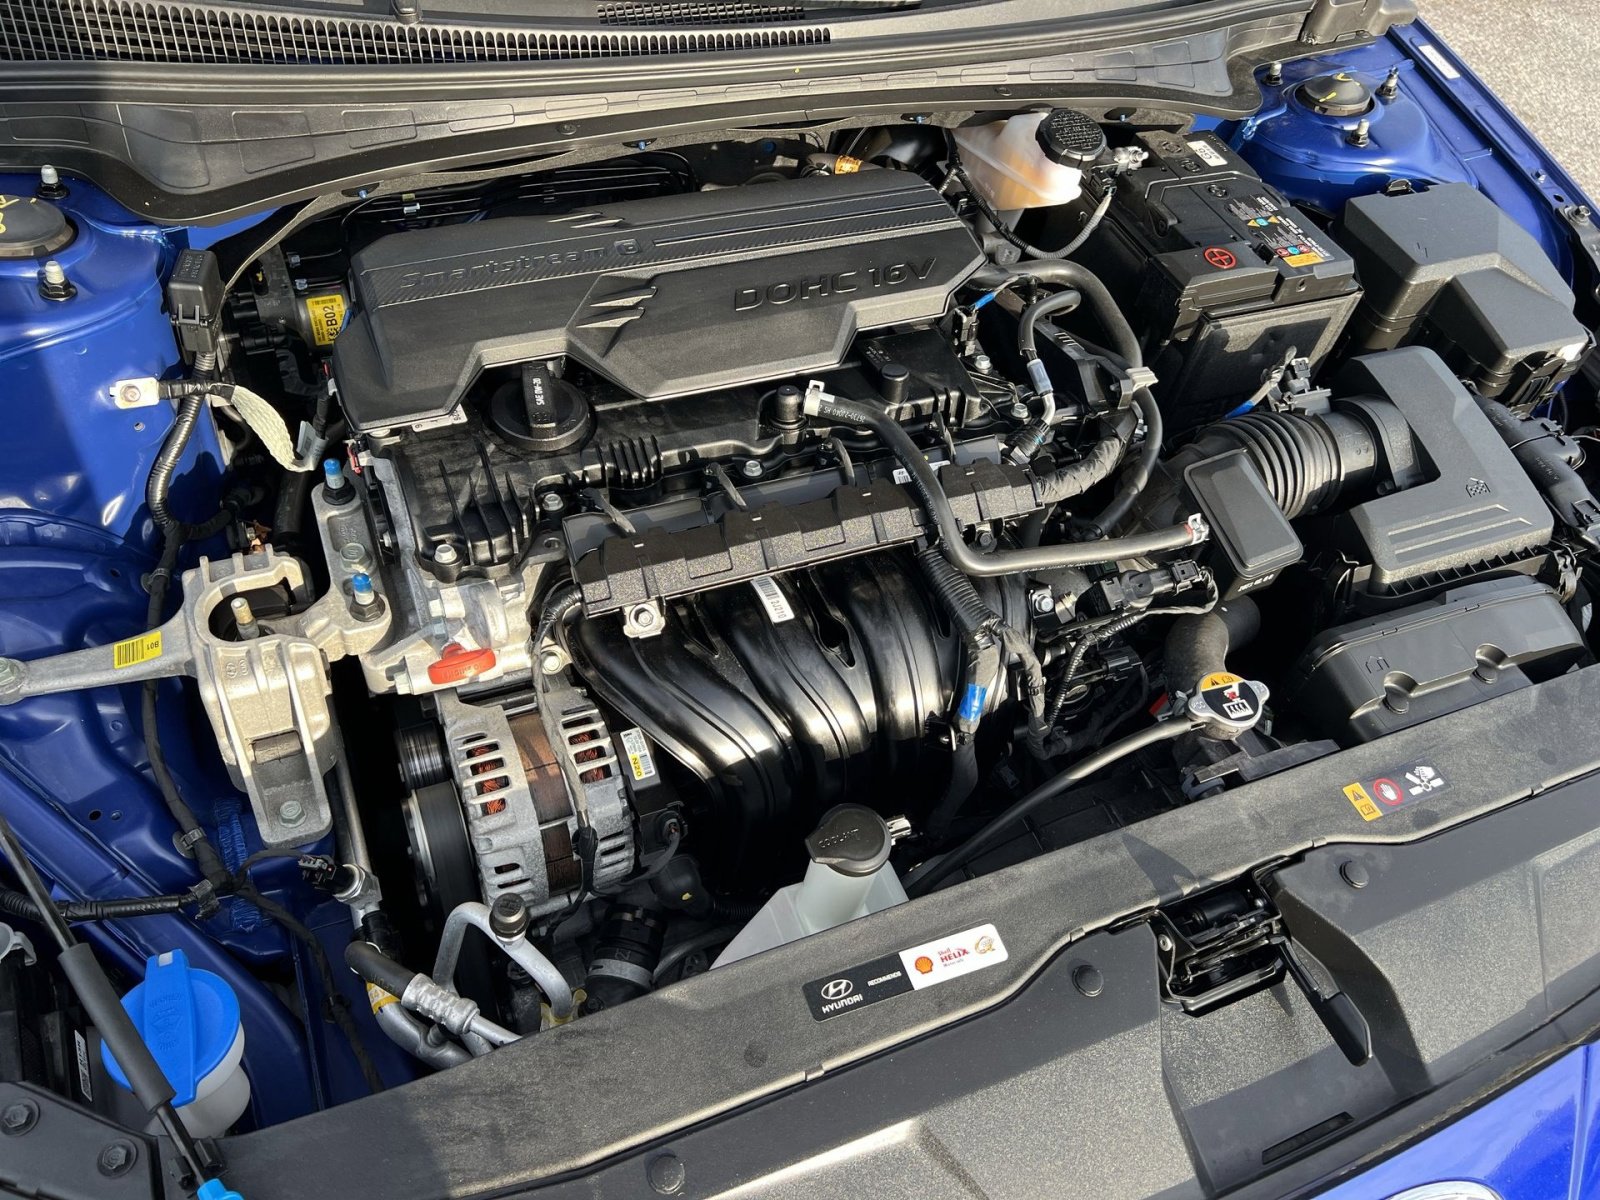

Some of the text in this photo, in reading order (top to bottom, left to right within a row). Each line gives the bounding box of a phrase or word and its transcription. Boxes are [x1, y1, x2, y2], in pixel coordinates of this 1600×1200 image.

[400, 247, 608, 289] Smartstream
[734, 257, 946, 312] DOHC 16V
[323, 305, 338, 327] B02
[534, 394, 545, 406] SAE
[146, 640, 160, 651] B01
[631, 756, 643, 777] N20
[940, 948, 969, 963] HELIX
[821, 993, 864, 1014] HYUNDAI
